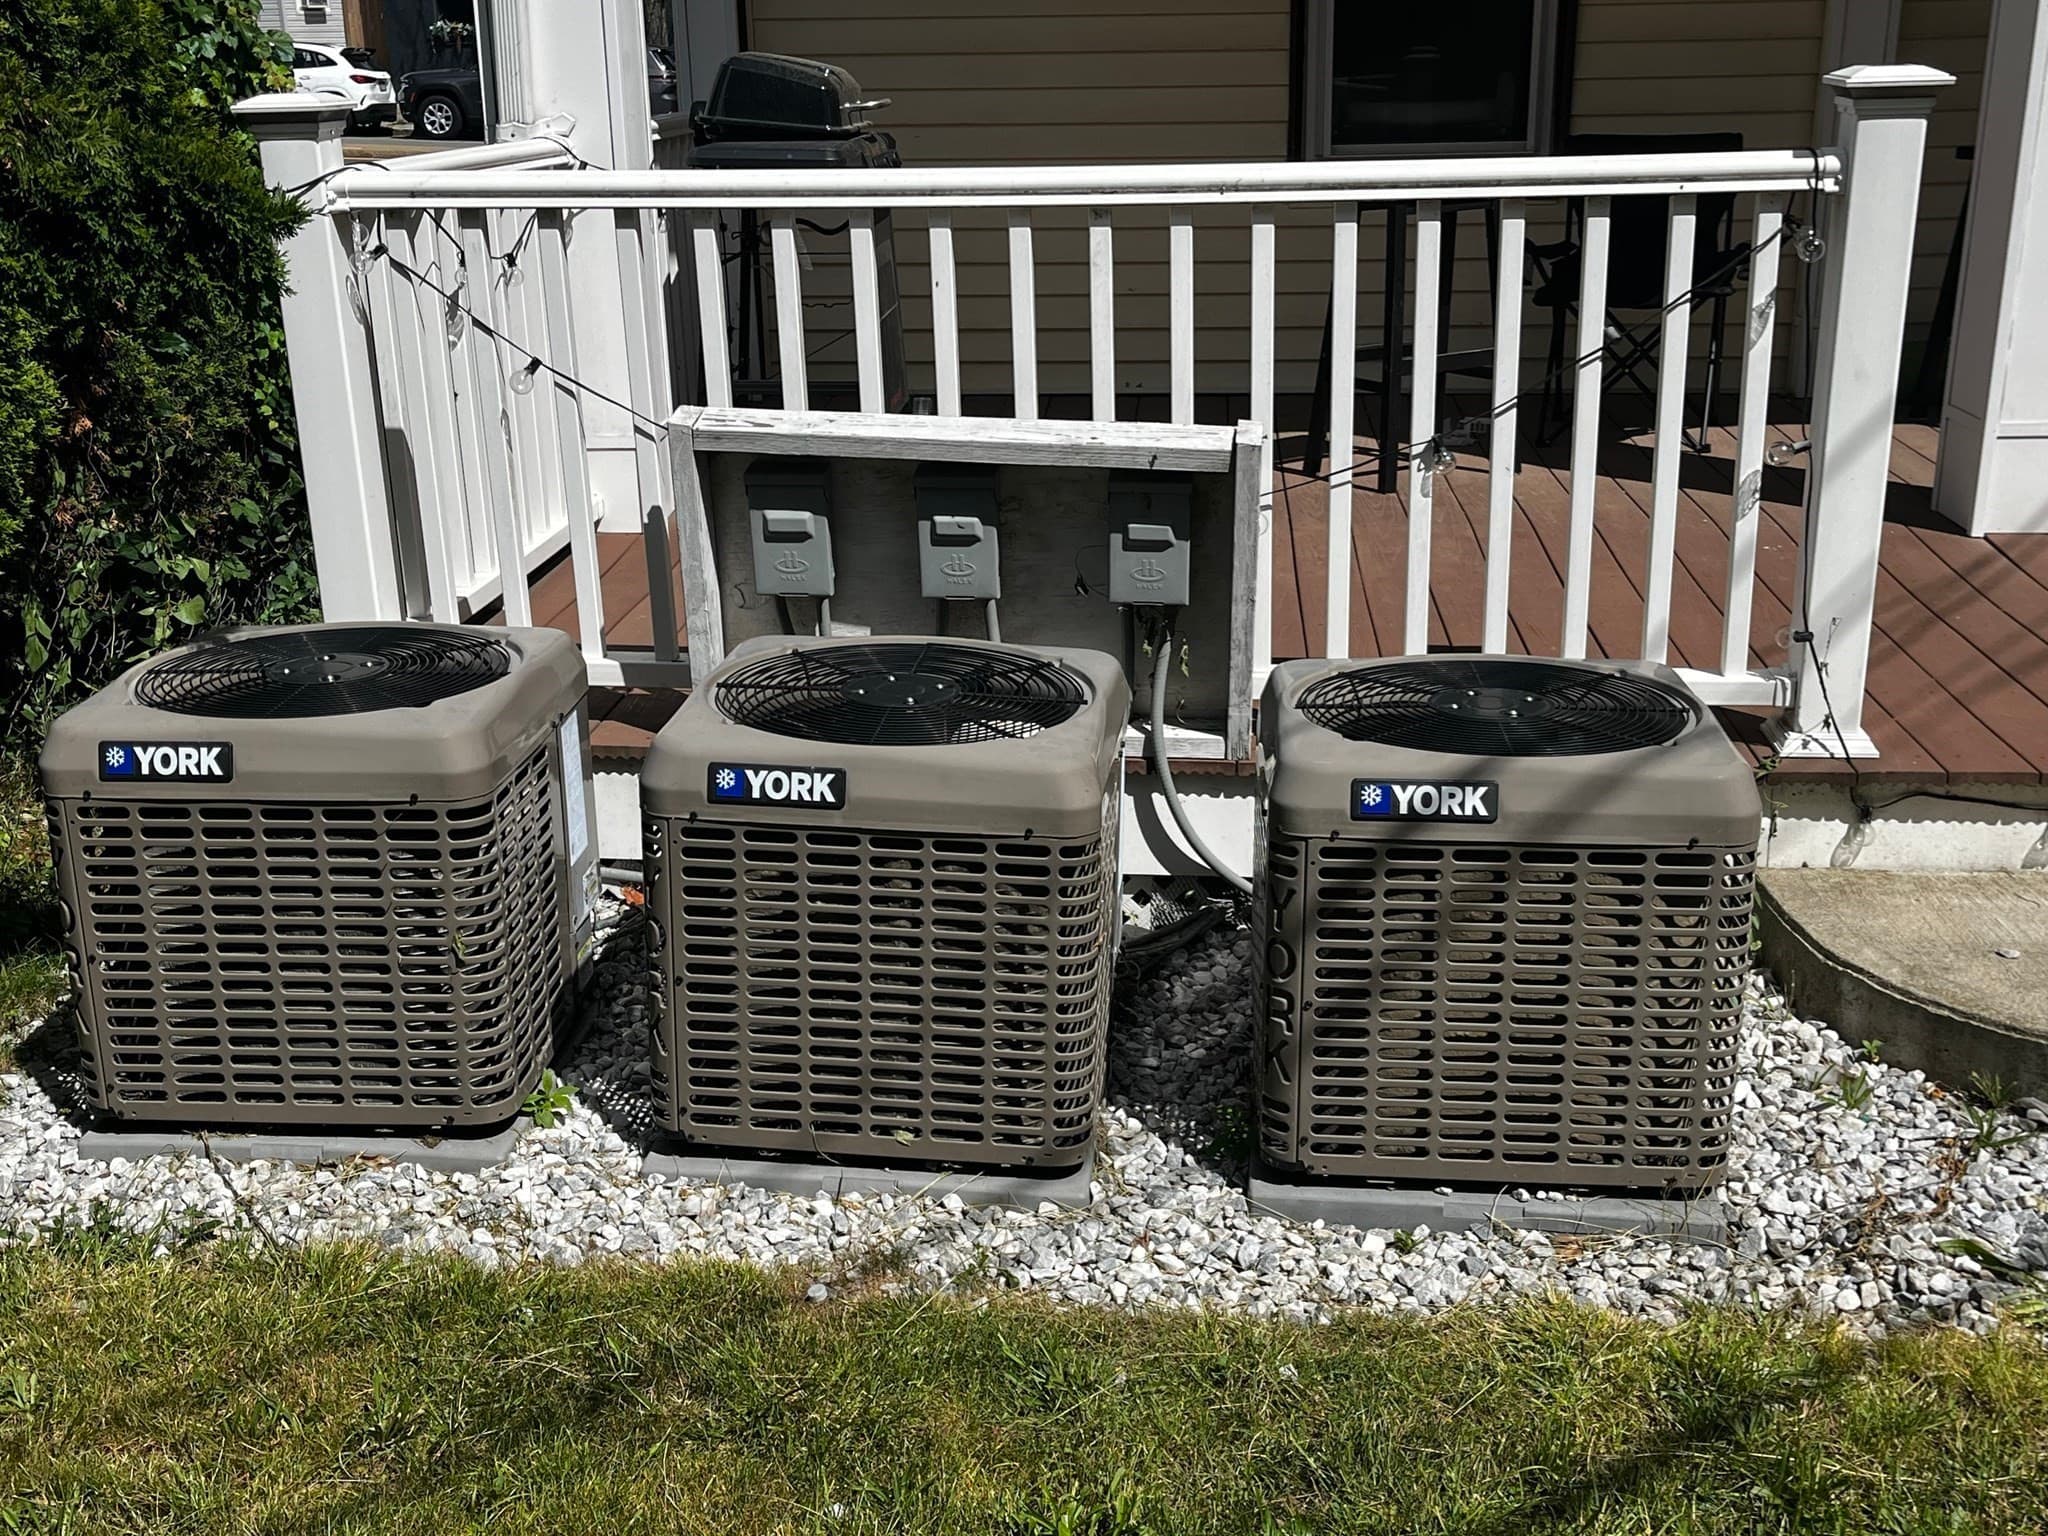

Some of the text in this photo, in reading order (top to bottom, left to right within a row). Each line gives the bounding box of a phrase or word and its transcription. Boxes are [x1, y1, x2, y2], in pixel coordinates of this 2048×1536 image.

[133, 746, 224, 776] YORK
[744, 769, 836, 803] YORK
[1391, 785, 1489, 816] YORK
